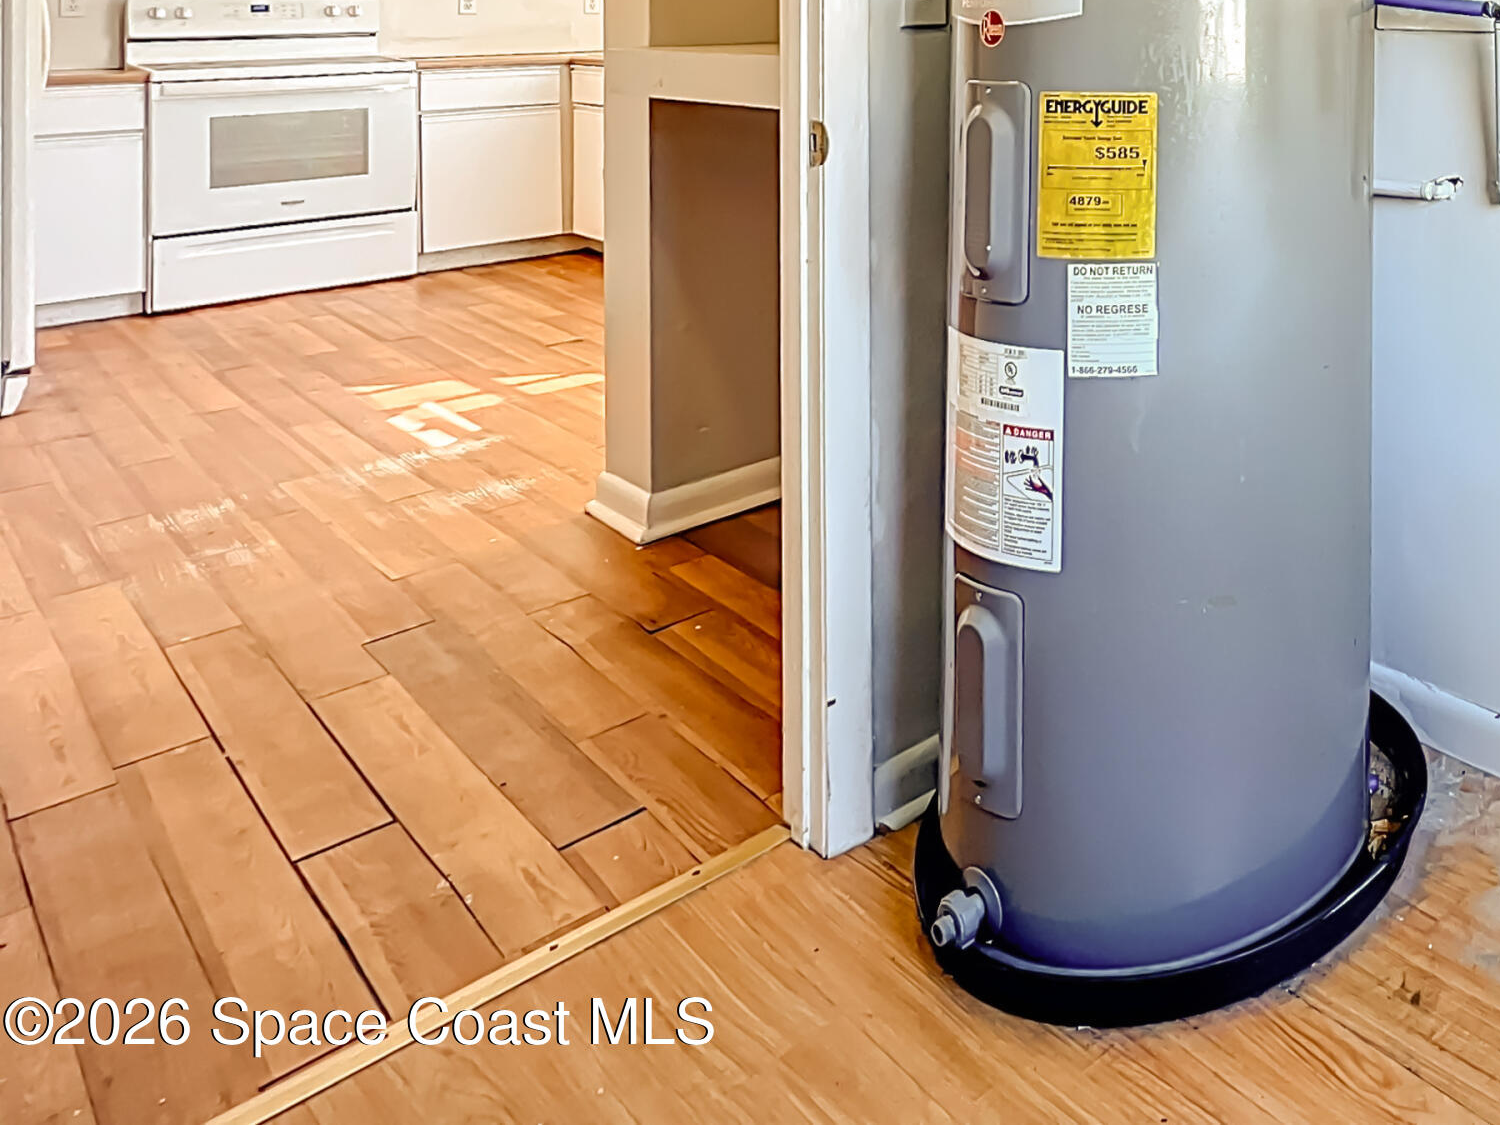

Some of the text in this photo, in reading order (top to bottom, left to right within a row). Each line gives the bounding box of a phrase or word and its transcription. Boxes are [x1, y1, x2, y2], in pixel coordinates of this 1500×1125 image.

[1045, 99, 1148, 115] ENERGYGUIDE
[1095, 146, 1140, 160] $585
[1069, 195, 1101, 206] 4879
[1073, 265, 1153, 276] DO NOT RETURN
[1077, 304, 1149, 315] NO REGRESE
[1013, 427, 1051, 439] DANGER
